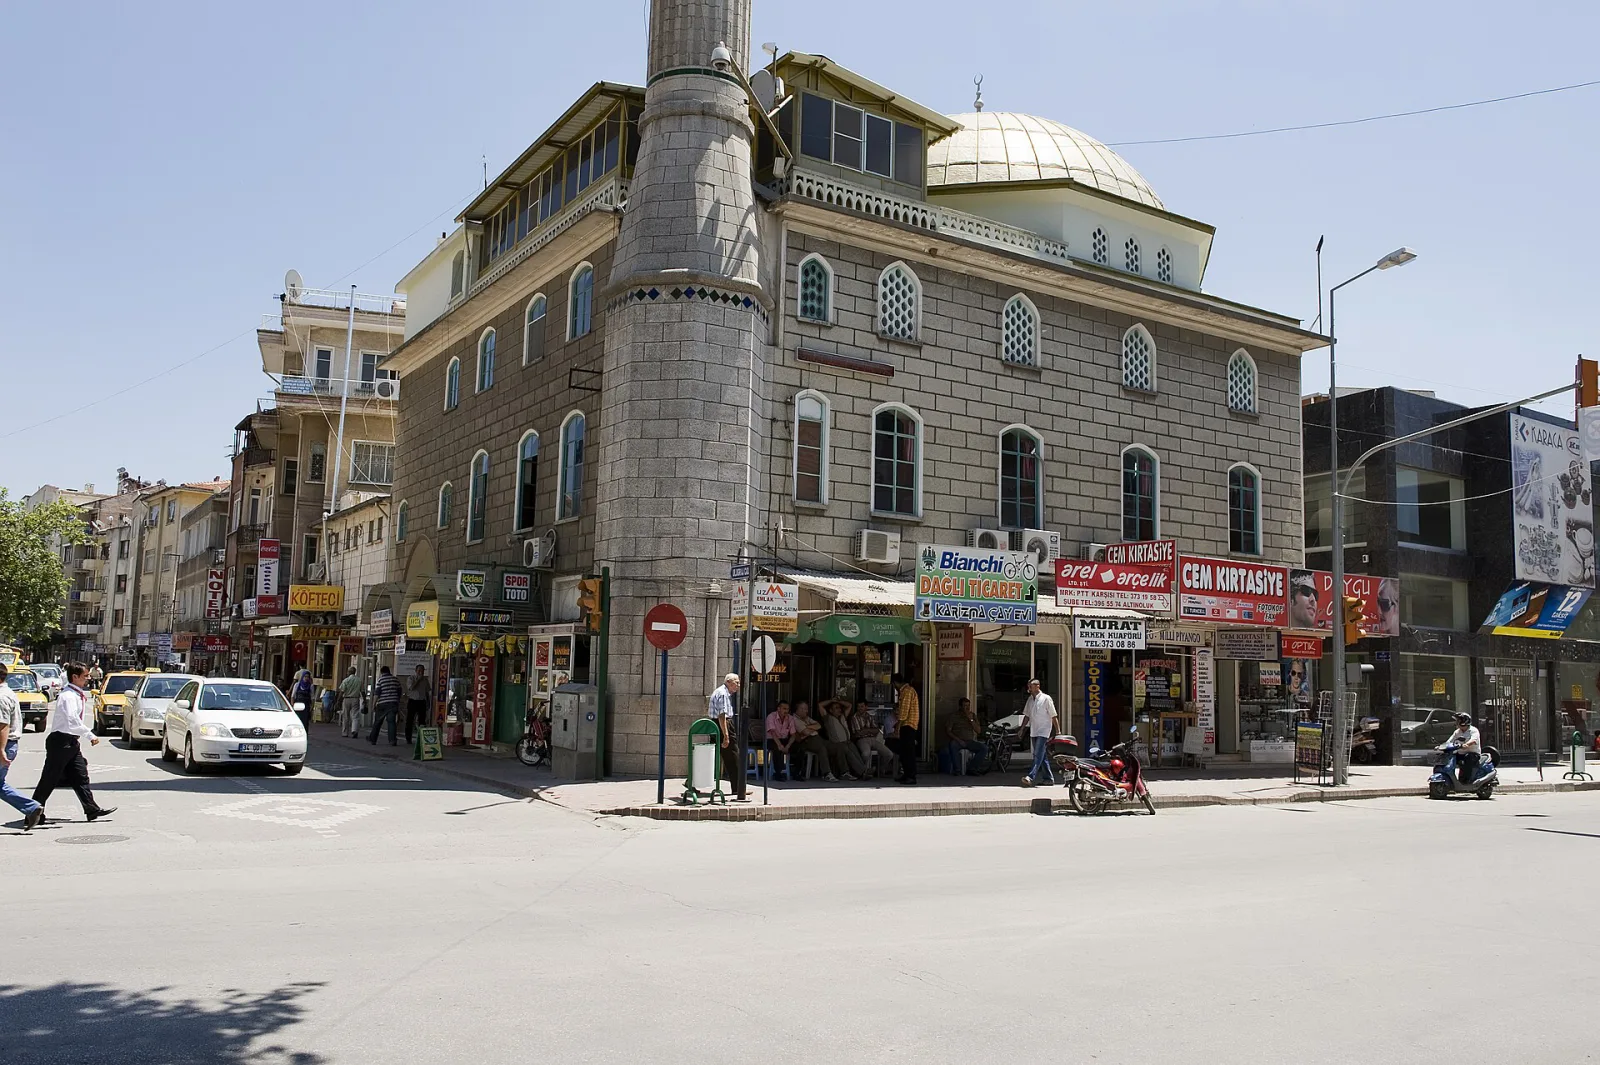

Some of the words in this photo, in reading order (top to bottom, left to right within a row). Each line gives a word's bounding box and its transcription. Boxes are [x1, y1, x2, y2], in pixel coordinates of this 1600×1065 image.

[1531, 426, 1564, 450] KARACA
[940, 551, 1004, 573] Bianchi
[1107, 546, 1126, 564] CEM
[1128, 541, 1173, 563] KIRTASİYE
[462, 574, 483, 584] iddaa
[505, 575, 528, 587] SPOR
[920, 571, 965, 597] DAĞLI
[968, 573, 1023, 600] TİCARET
[1060, 563, 1098, 580] arel
[1116, 572, 1168, 589] arçelik
[1182, 562, 1213, 591] CEM
[1216, 565, 1284, 597] KIRTASİYE
[206, 569, 223, 618] NOTER
[505, 588, 527, 600] TOTO
[1323, 575, 1371, 598] DYGU
[291, 588, 340, 607] KÖFTECİ
[1122, 601, 1154, 609] ALTINOLUK
[1556, 591, 1582, 612] 12
[484, 612, 512, 623] FOTOKOP
[935, 602, 986, 620] KARİZMA
[988, 606, 1012, 622] ÇAY
[1014, 607, 1033, 621] EVİ
[1264, 612, 1276, 620] FAX
[1079, 619, 1142, 631] MURAT
[1079, 631, 1106, 639] ERKEK
[1108, 631, 1142, 640] KUAFÖRÜ
[1115, 640, 1125, 648] 08
[1175, 631, 1201, 643] PİYANGO
[344, 644, 359, 653] WC
[1087, 660, 1101, 725] FOTOKOPİ
[477, 718, 485, 739] FAKS
